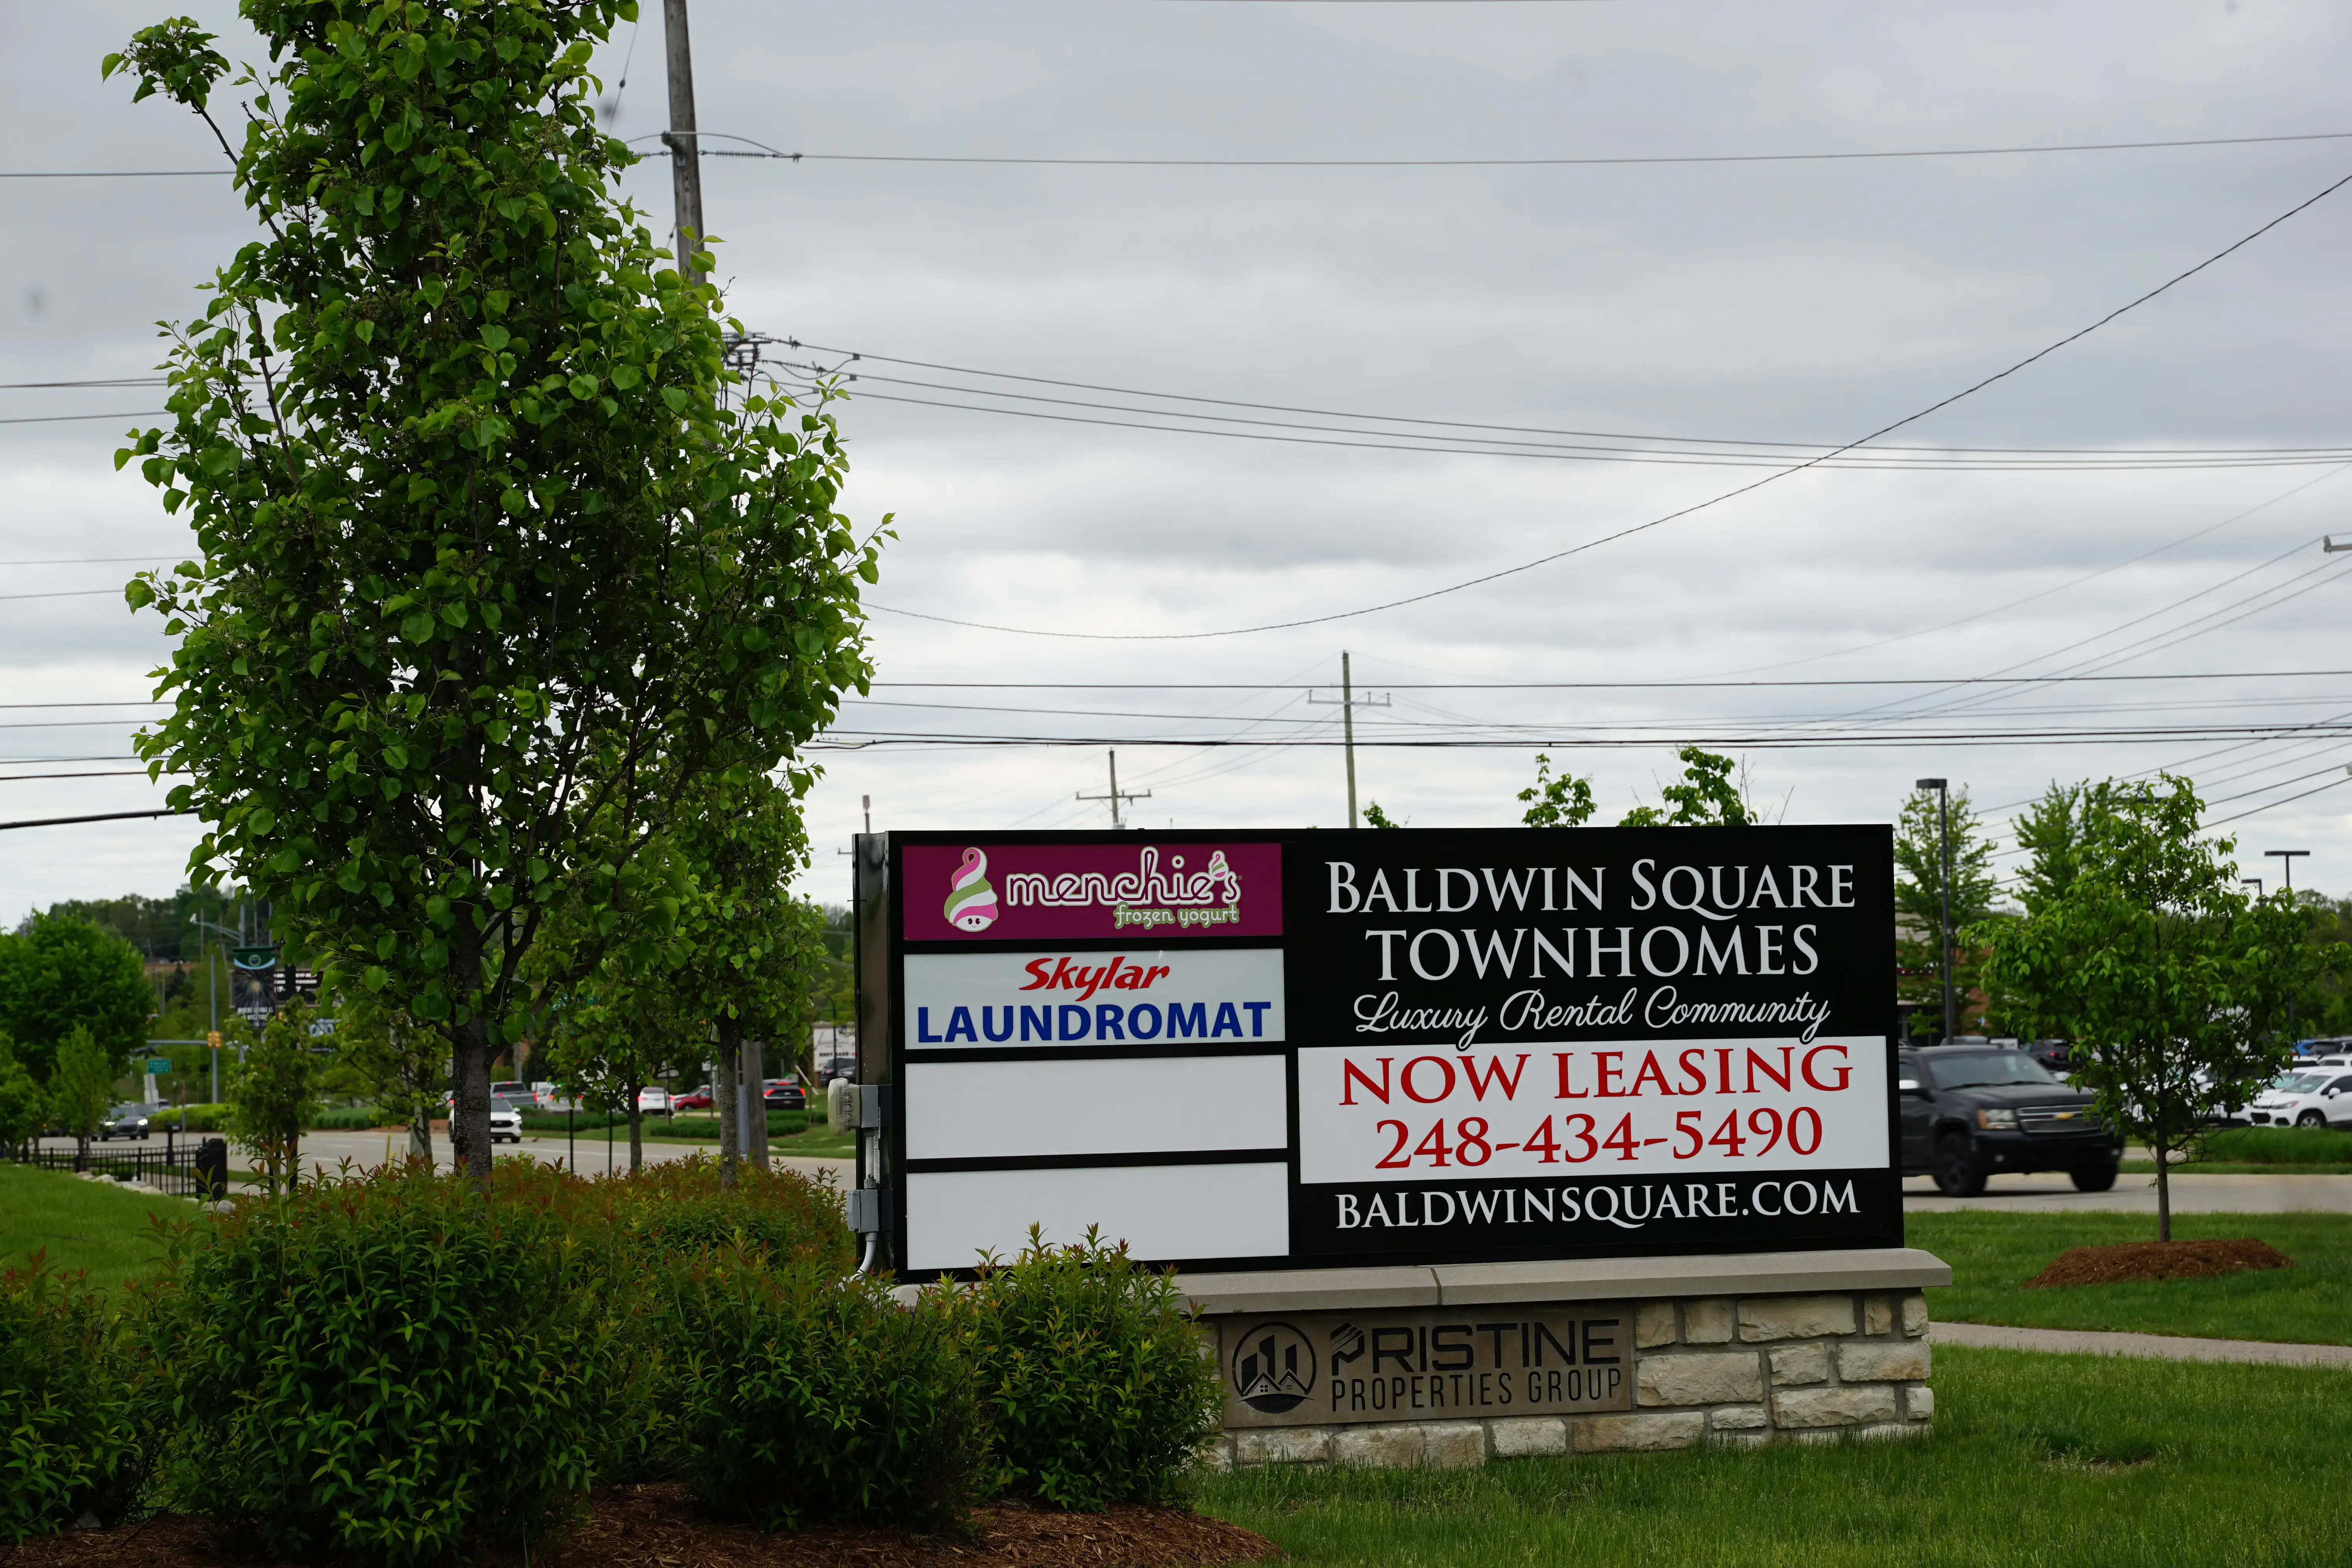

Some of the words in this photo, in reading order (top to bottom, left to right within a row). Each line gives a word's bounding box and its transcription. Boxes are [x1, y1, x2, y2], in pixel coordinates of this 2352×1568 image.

[1005, 846, 1241, 906] menchie's
[1325, 861, 1606, 913] BALDWIN
[1631, 858, 1855, 921] SQUARE
[1115, 904, 1173, 927] frozen
[1180, 904, 1237, 926] yogurt
[1019, 956, 1170, 1002] Skylar
[1365, 924, 1818, 981] TOWNHOMES
[918, 1002, 1271, 1043] LAUNDROMAT
[1354, 991, 1488, 1051] Luxury
[1500, 987, 1638, 1031] Rental
[1645, 985, 1831, 1043] Community
[1339, 1053, 1531, 1105] NOW
[1553, 1044, 1852, 1099] LEASING
[1374, 1105, 1822, 1169] 248-434-5490
[1336, 1179, 1861, 1229] BALDWINSQUARE.COM
[1331, 1319, 1621, 1376] PRISTINE
[1332, 1372, 1512, 1412] PROPERTIES
[1528, 1368, 1621, 1404] GROUP
